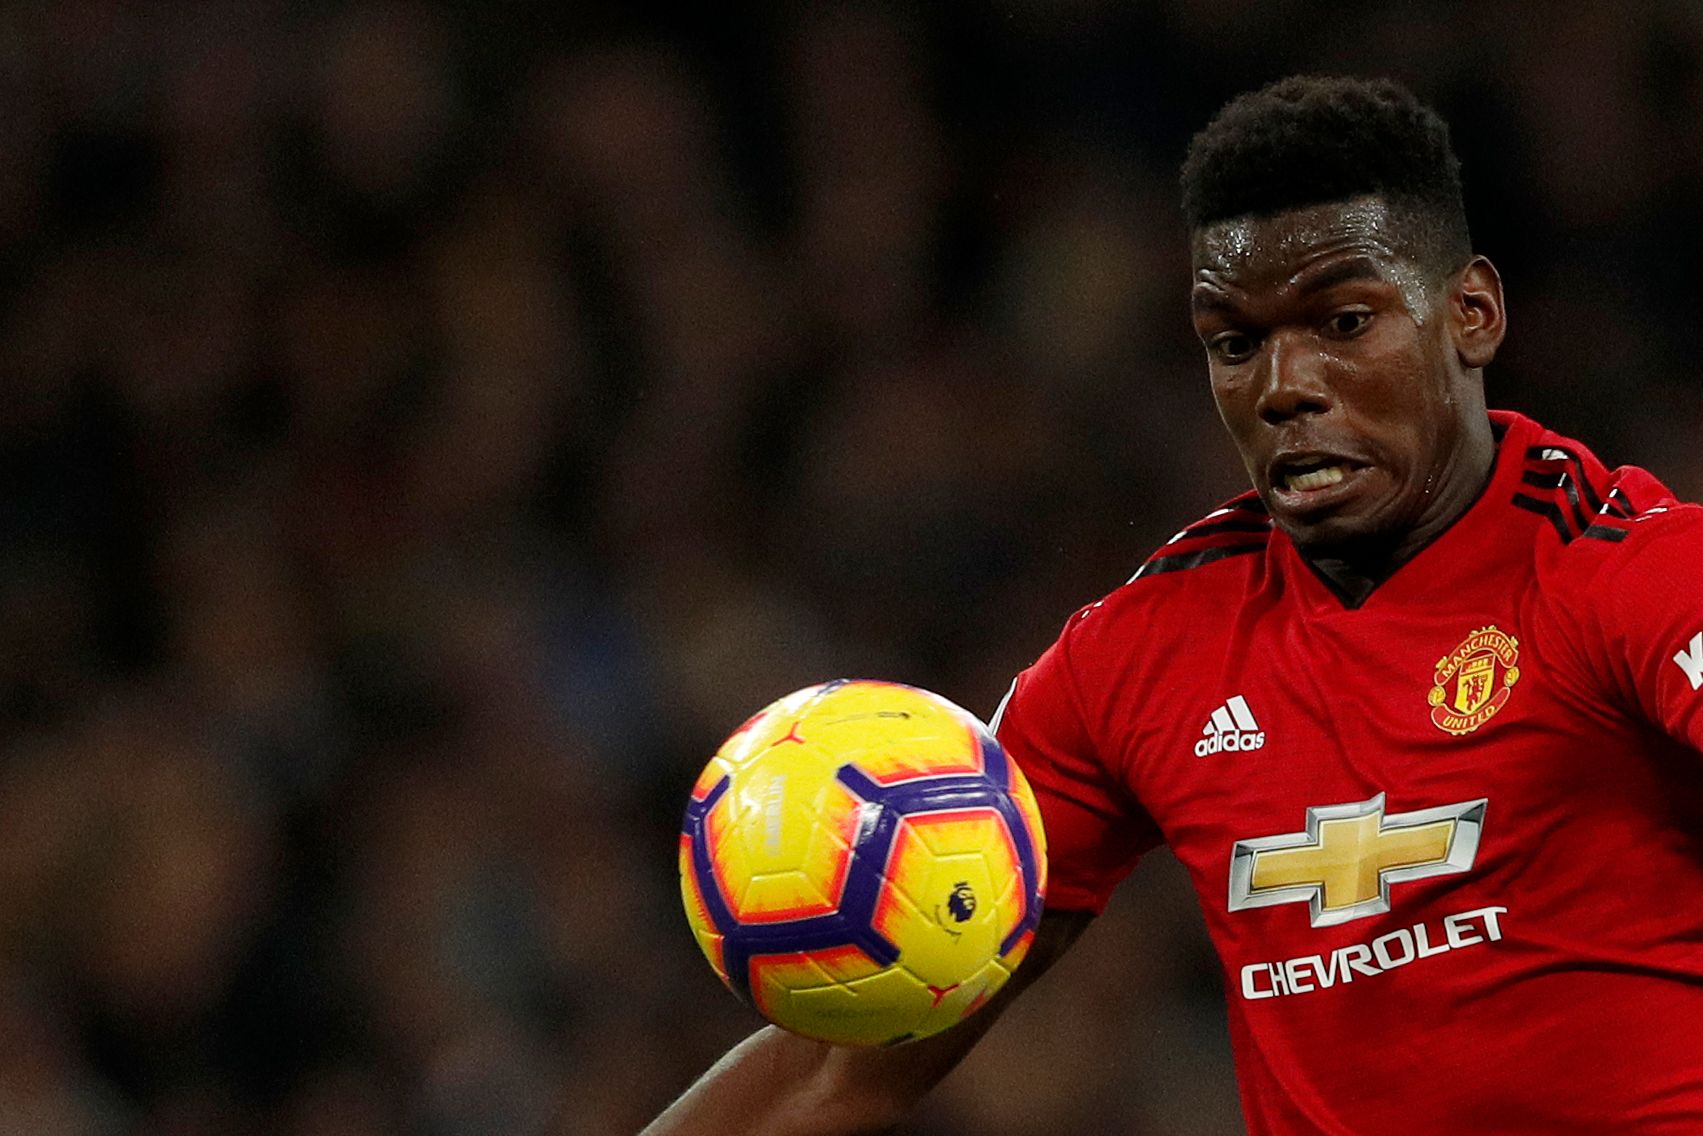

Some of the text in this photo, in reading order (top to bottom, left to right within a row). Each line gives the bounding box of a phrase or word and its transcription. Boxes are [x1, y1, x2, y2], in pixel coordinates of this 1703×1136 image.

[1442, 634, 1513, 677] MANCHESTER
[1443, 705, 1496, 728] UNITED
[1194, 729, 1265, 758] adidas
[1241, 906, 1508, 1000] CHEVROLET
